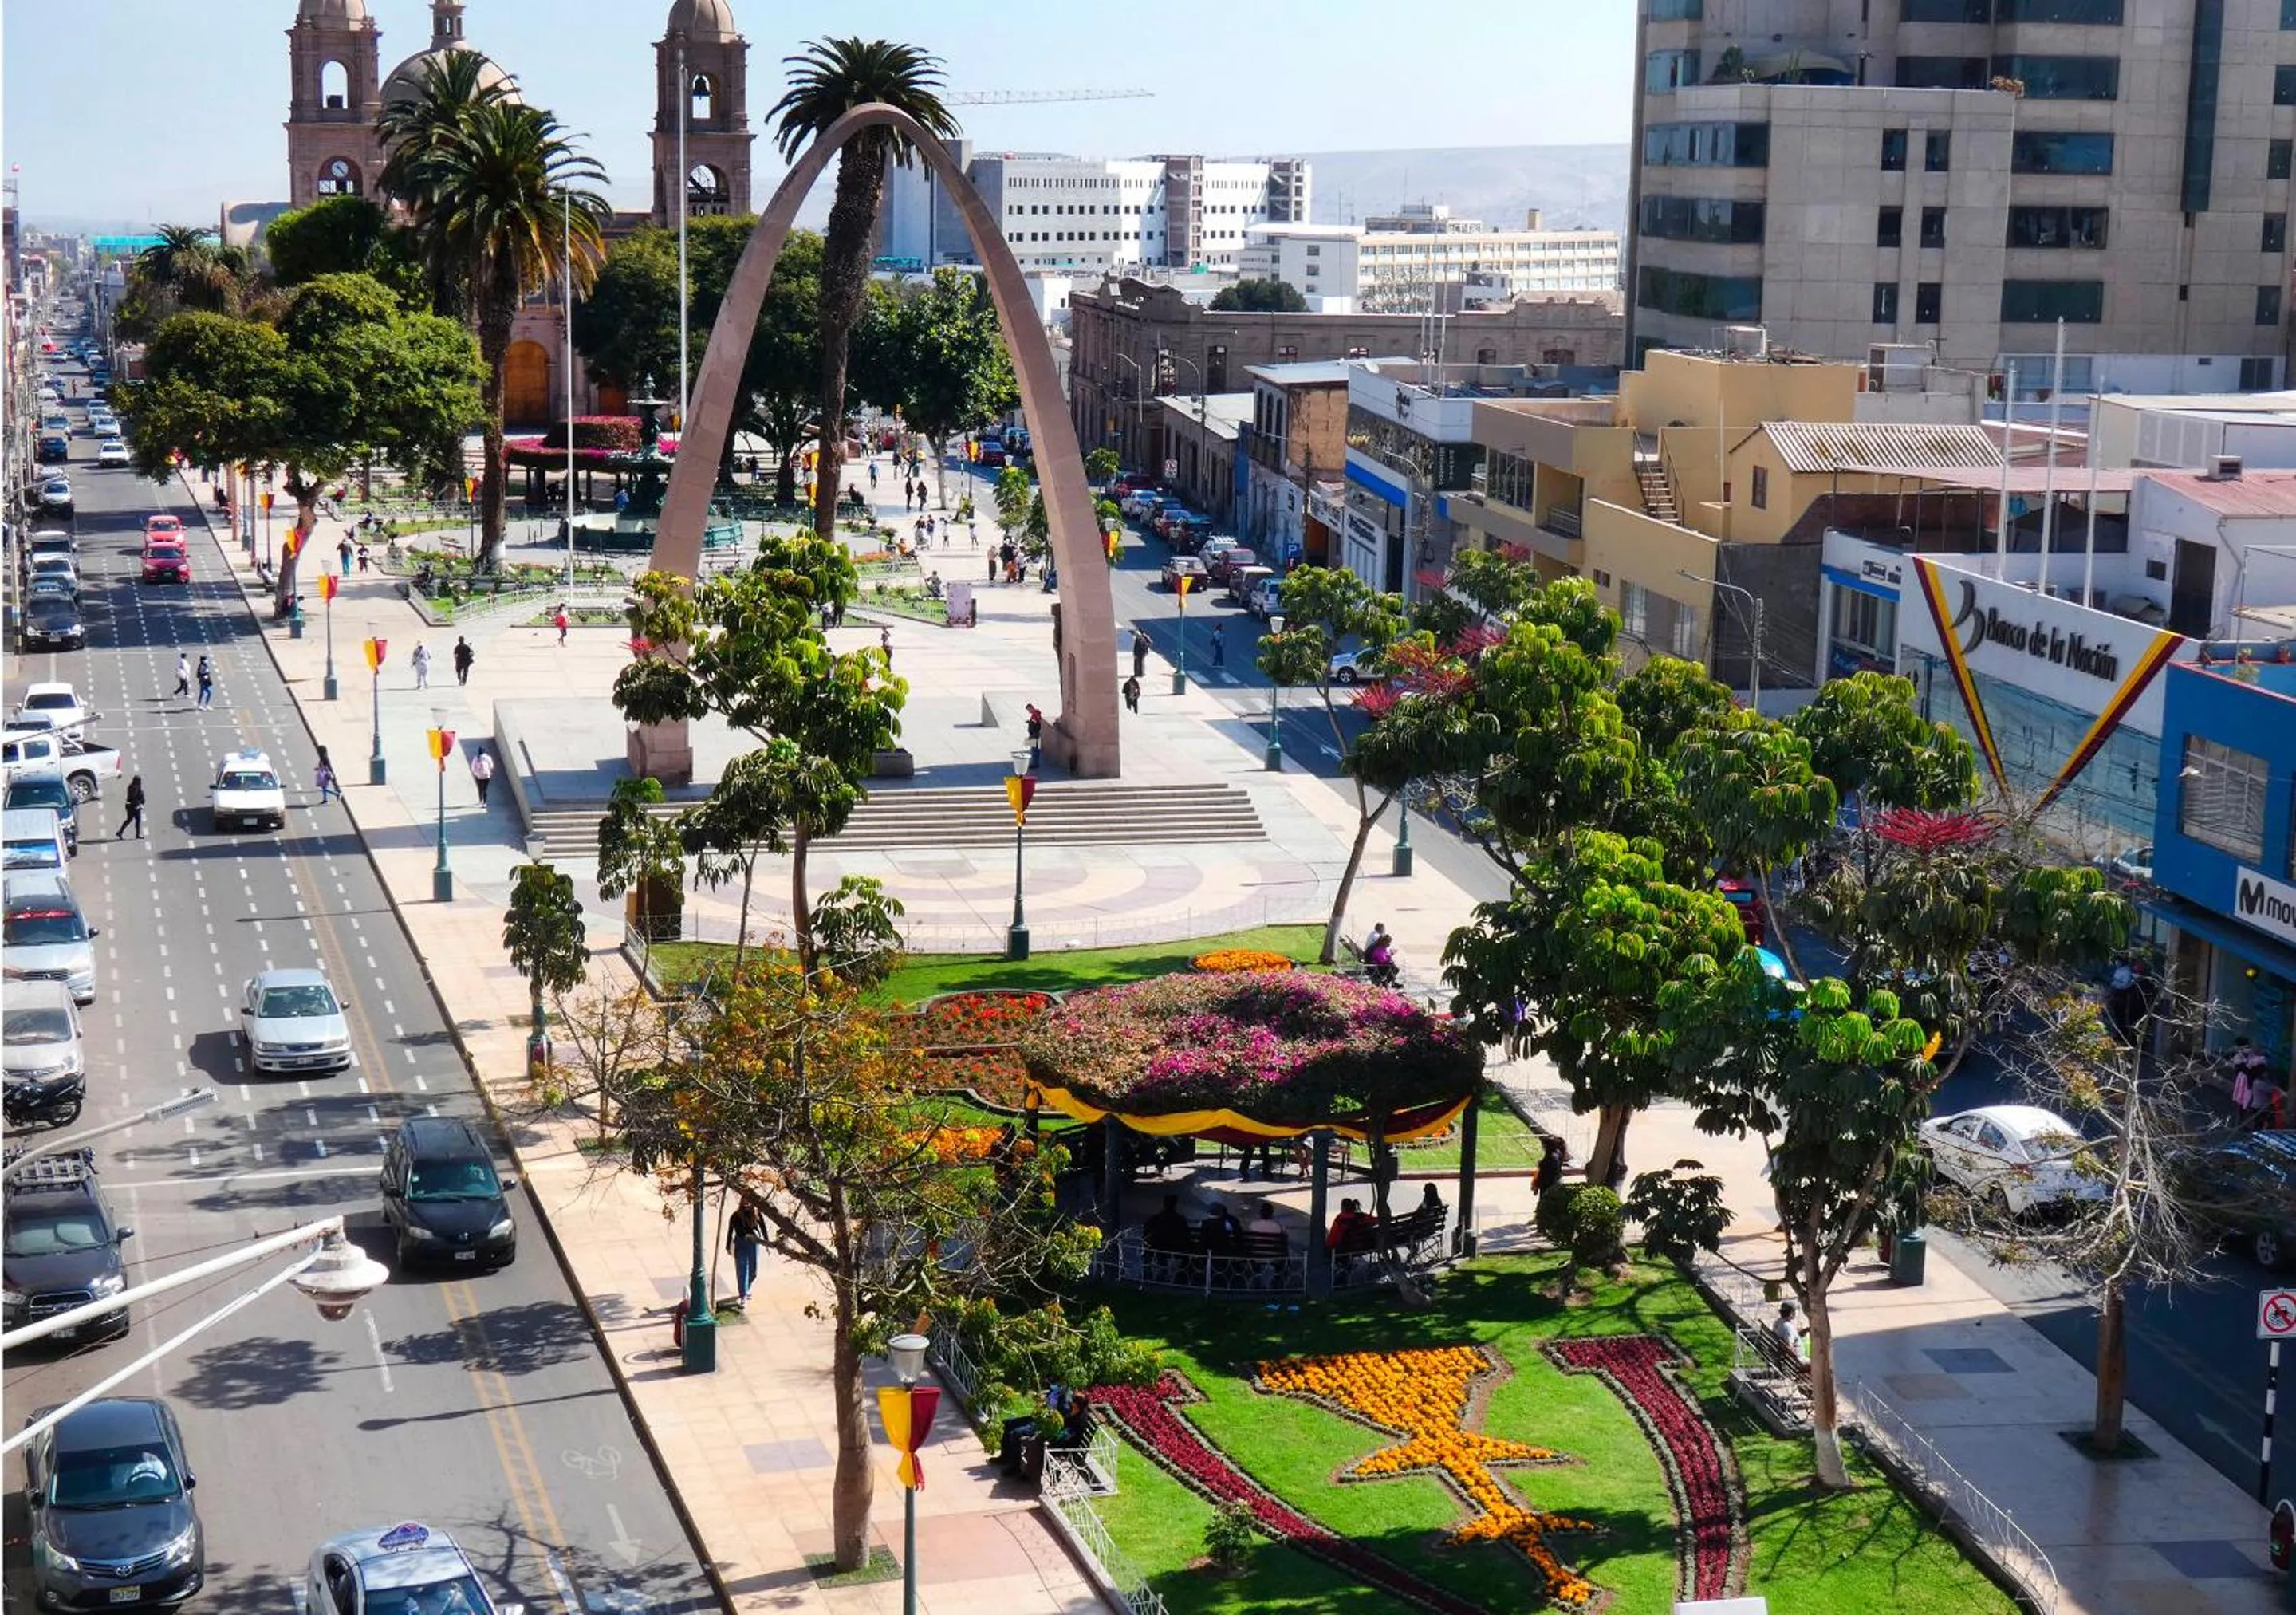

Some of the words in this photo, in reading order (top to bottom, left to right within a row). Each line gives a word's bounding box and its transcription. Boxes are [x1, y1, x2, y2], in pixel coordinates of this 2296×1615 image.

[1288, 544, 1297, 556] P
[1985, 607, 2027, 651] Banco
[2028, 620, 2047, 658] de
[2048, 626, 2066, 664] la
[2066, 632, 2118, 682] Nación
